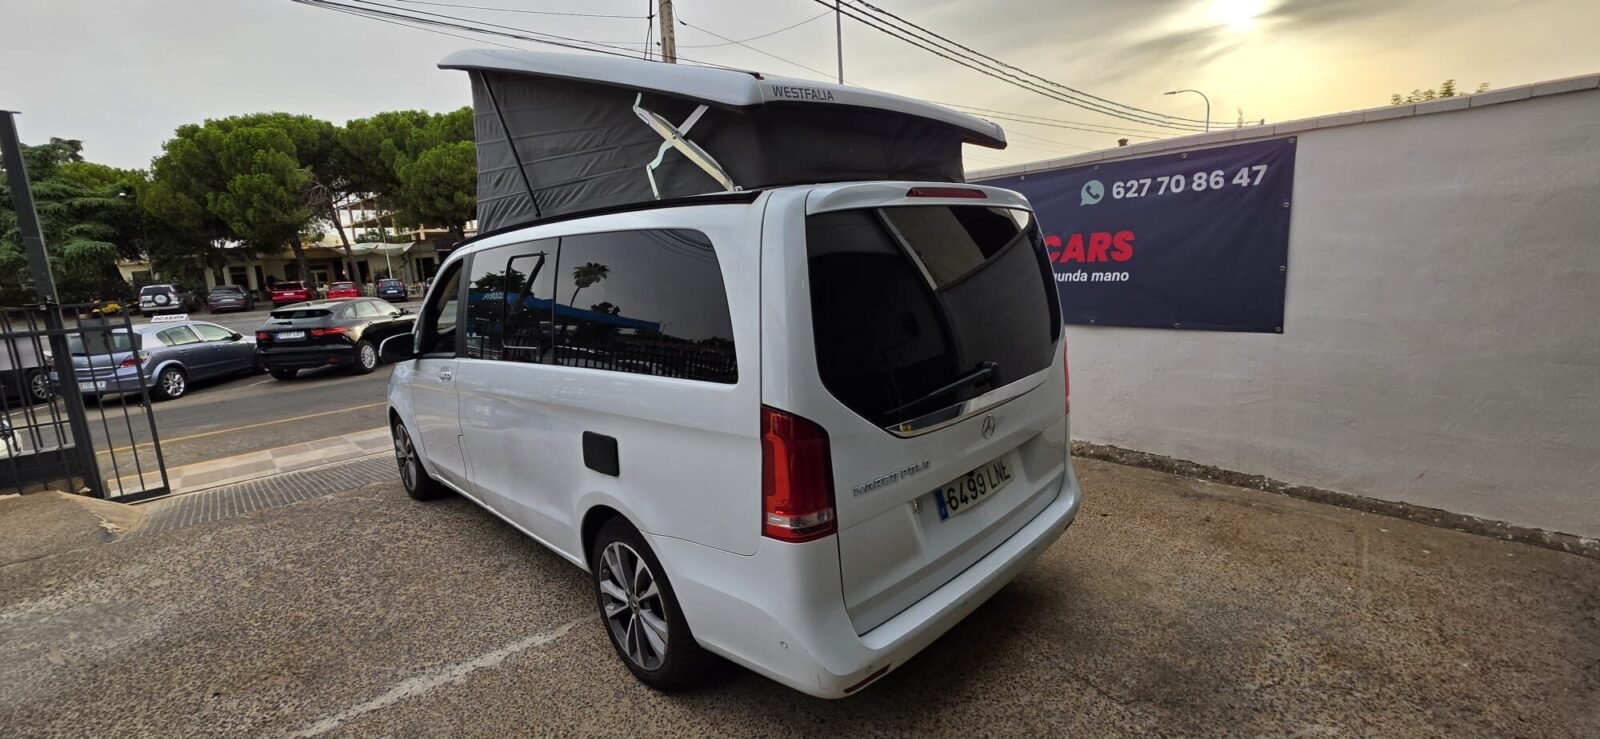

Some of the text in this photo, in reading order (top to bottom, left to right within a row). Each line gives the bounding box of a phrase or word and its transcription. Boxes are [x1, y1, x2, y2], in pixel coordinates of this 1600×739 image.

[772, 84, 835, 101] WESTFALIA
[1112, 164, 1268, 199] 627 70 86 47
[1044, 230, 1135, 263] CARS
[1091, 271, 1130, 282] mano
[947, 473, 987, 511] 6499
